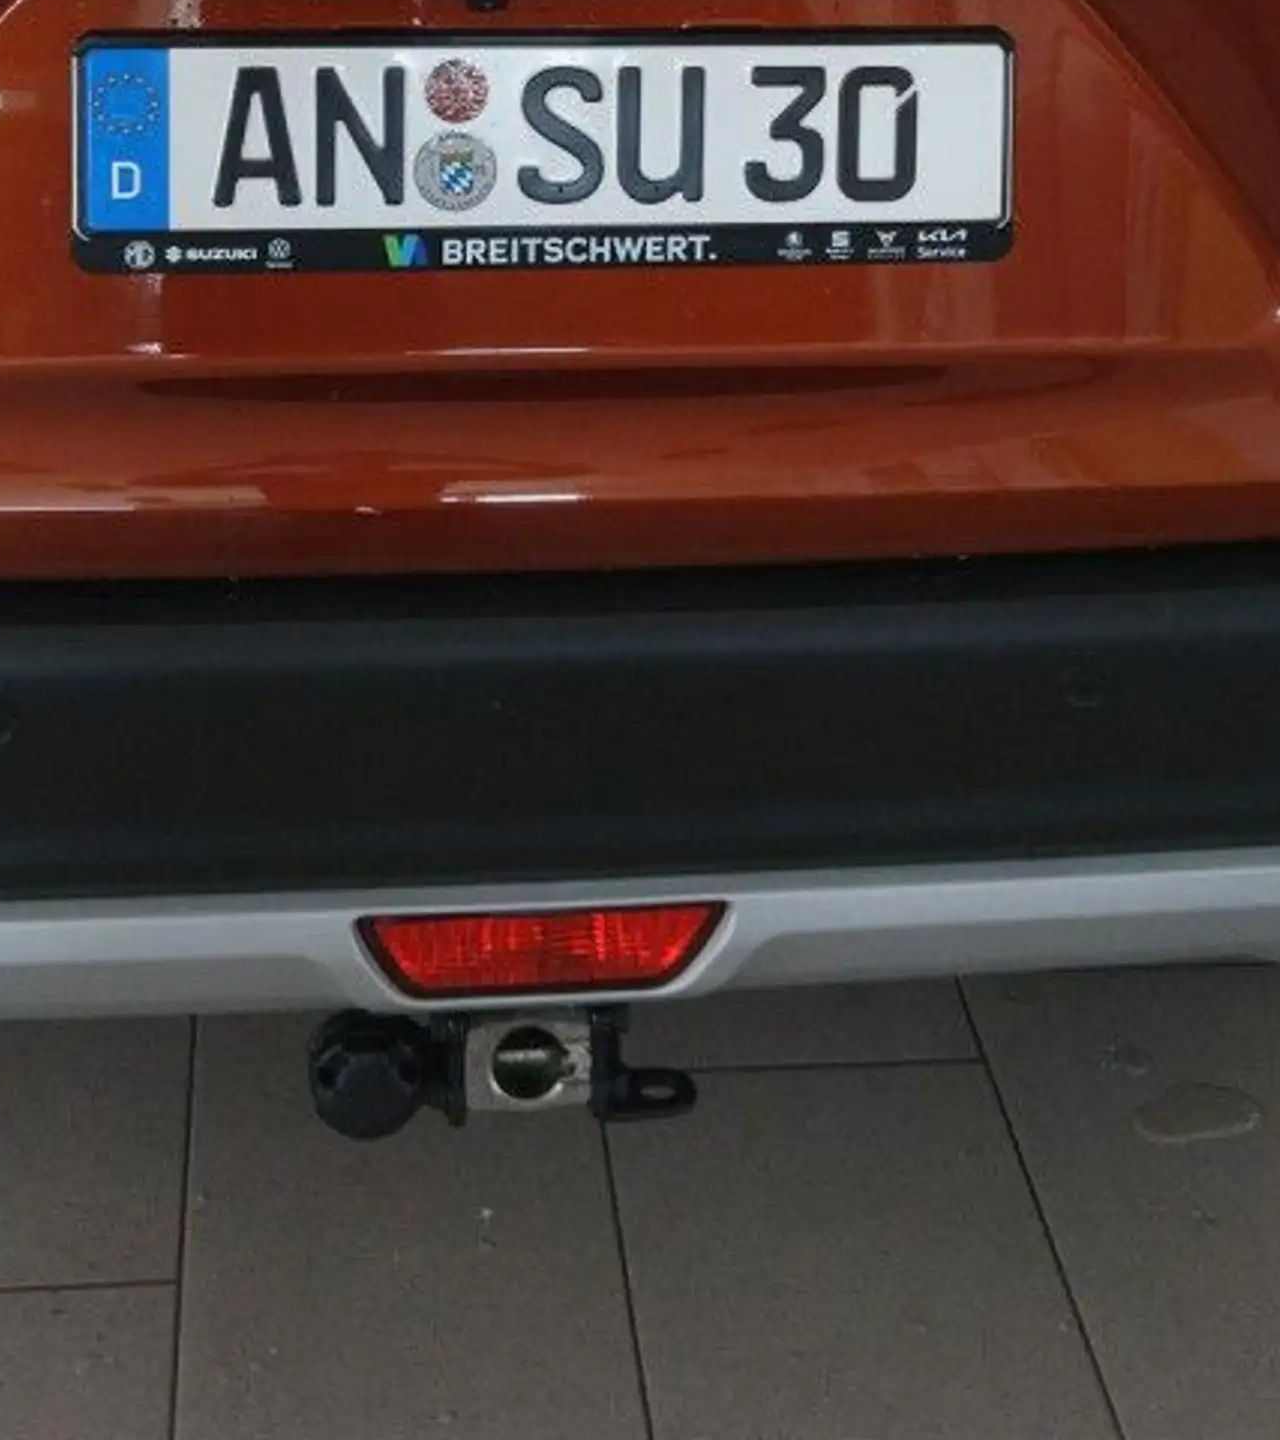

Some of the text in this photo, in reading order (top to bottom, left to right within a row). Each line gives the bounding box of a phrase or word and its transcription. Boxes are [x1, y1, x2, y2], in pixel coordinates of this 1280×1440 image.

[213, 64, 919, 207] AN SU 30
[112, 162, 142, 201] D
[186, 246, 258, 262] SUZUKI
[917, 246, 967, 260] Service
